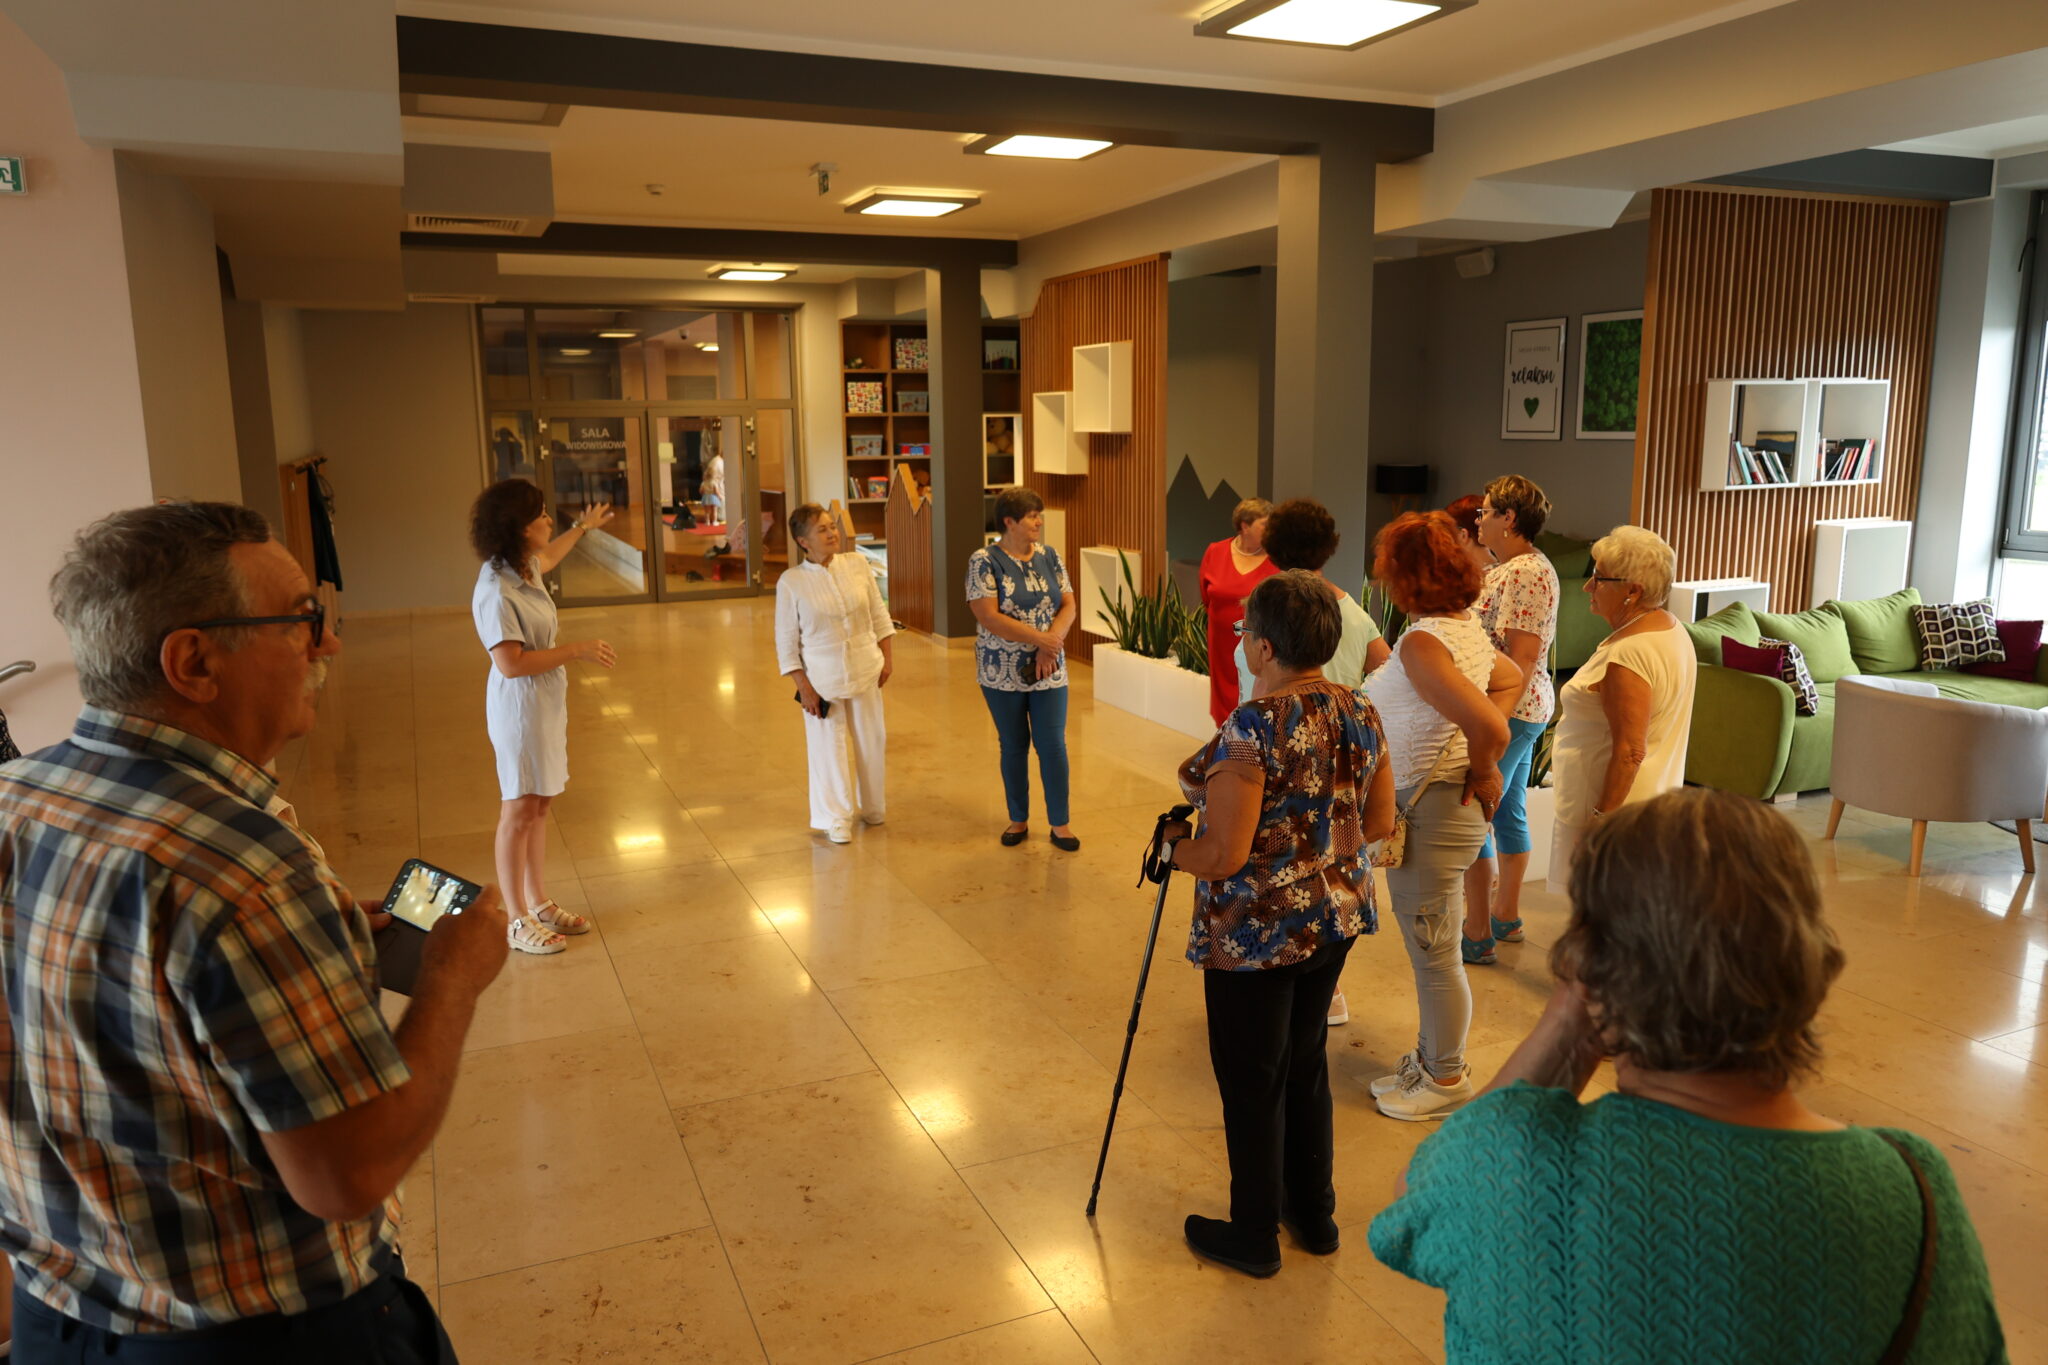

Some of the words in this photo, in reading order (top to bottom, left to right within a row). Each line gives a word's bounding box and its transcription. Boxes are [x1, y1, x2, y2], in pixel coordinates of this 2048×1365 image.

[1511, 366, 1555, 385] relaksu
[581, 428, 610, 438] SALA
[566, 441, 627, 450] WIDOWISKOWA
